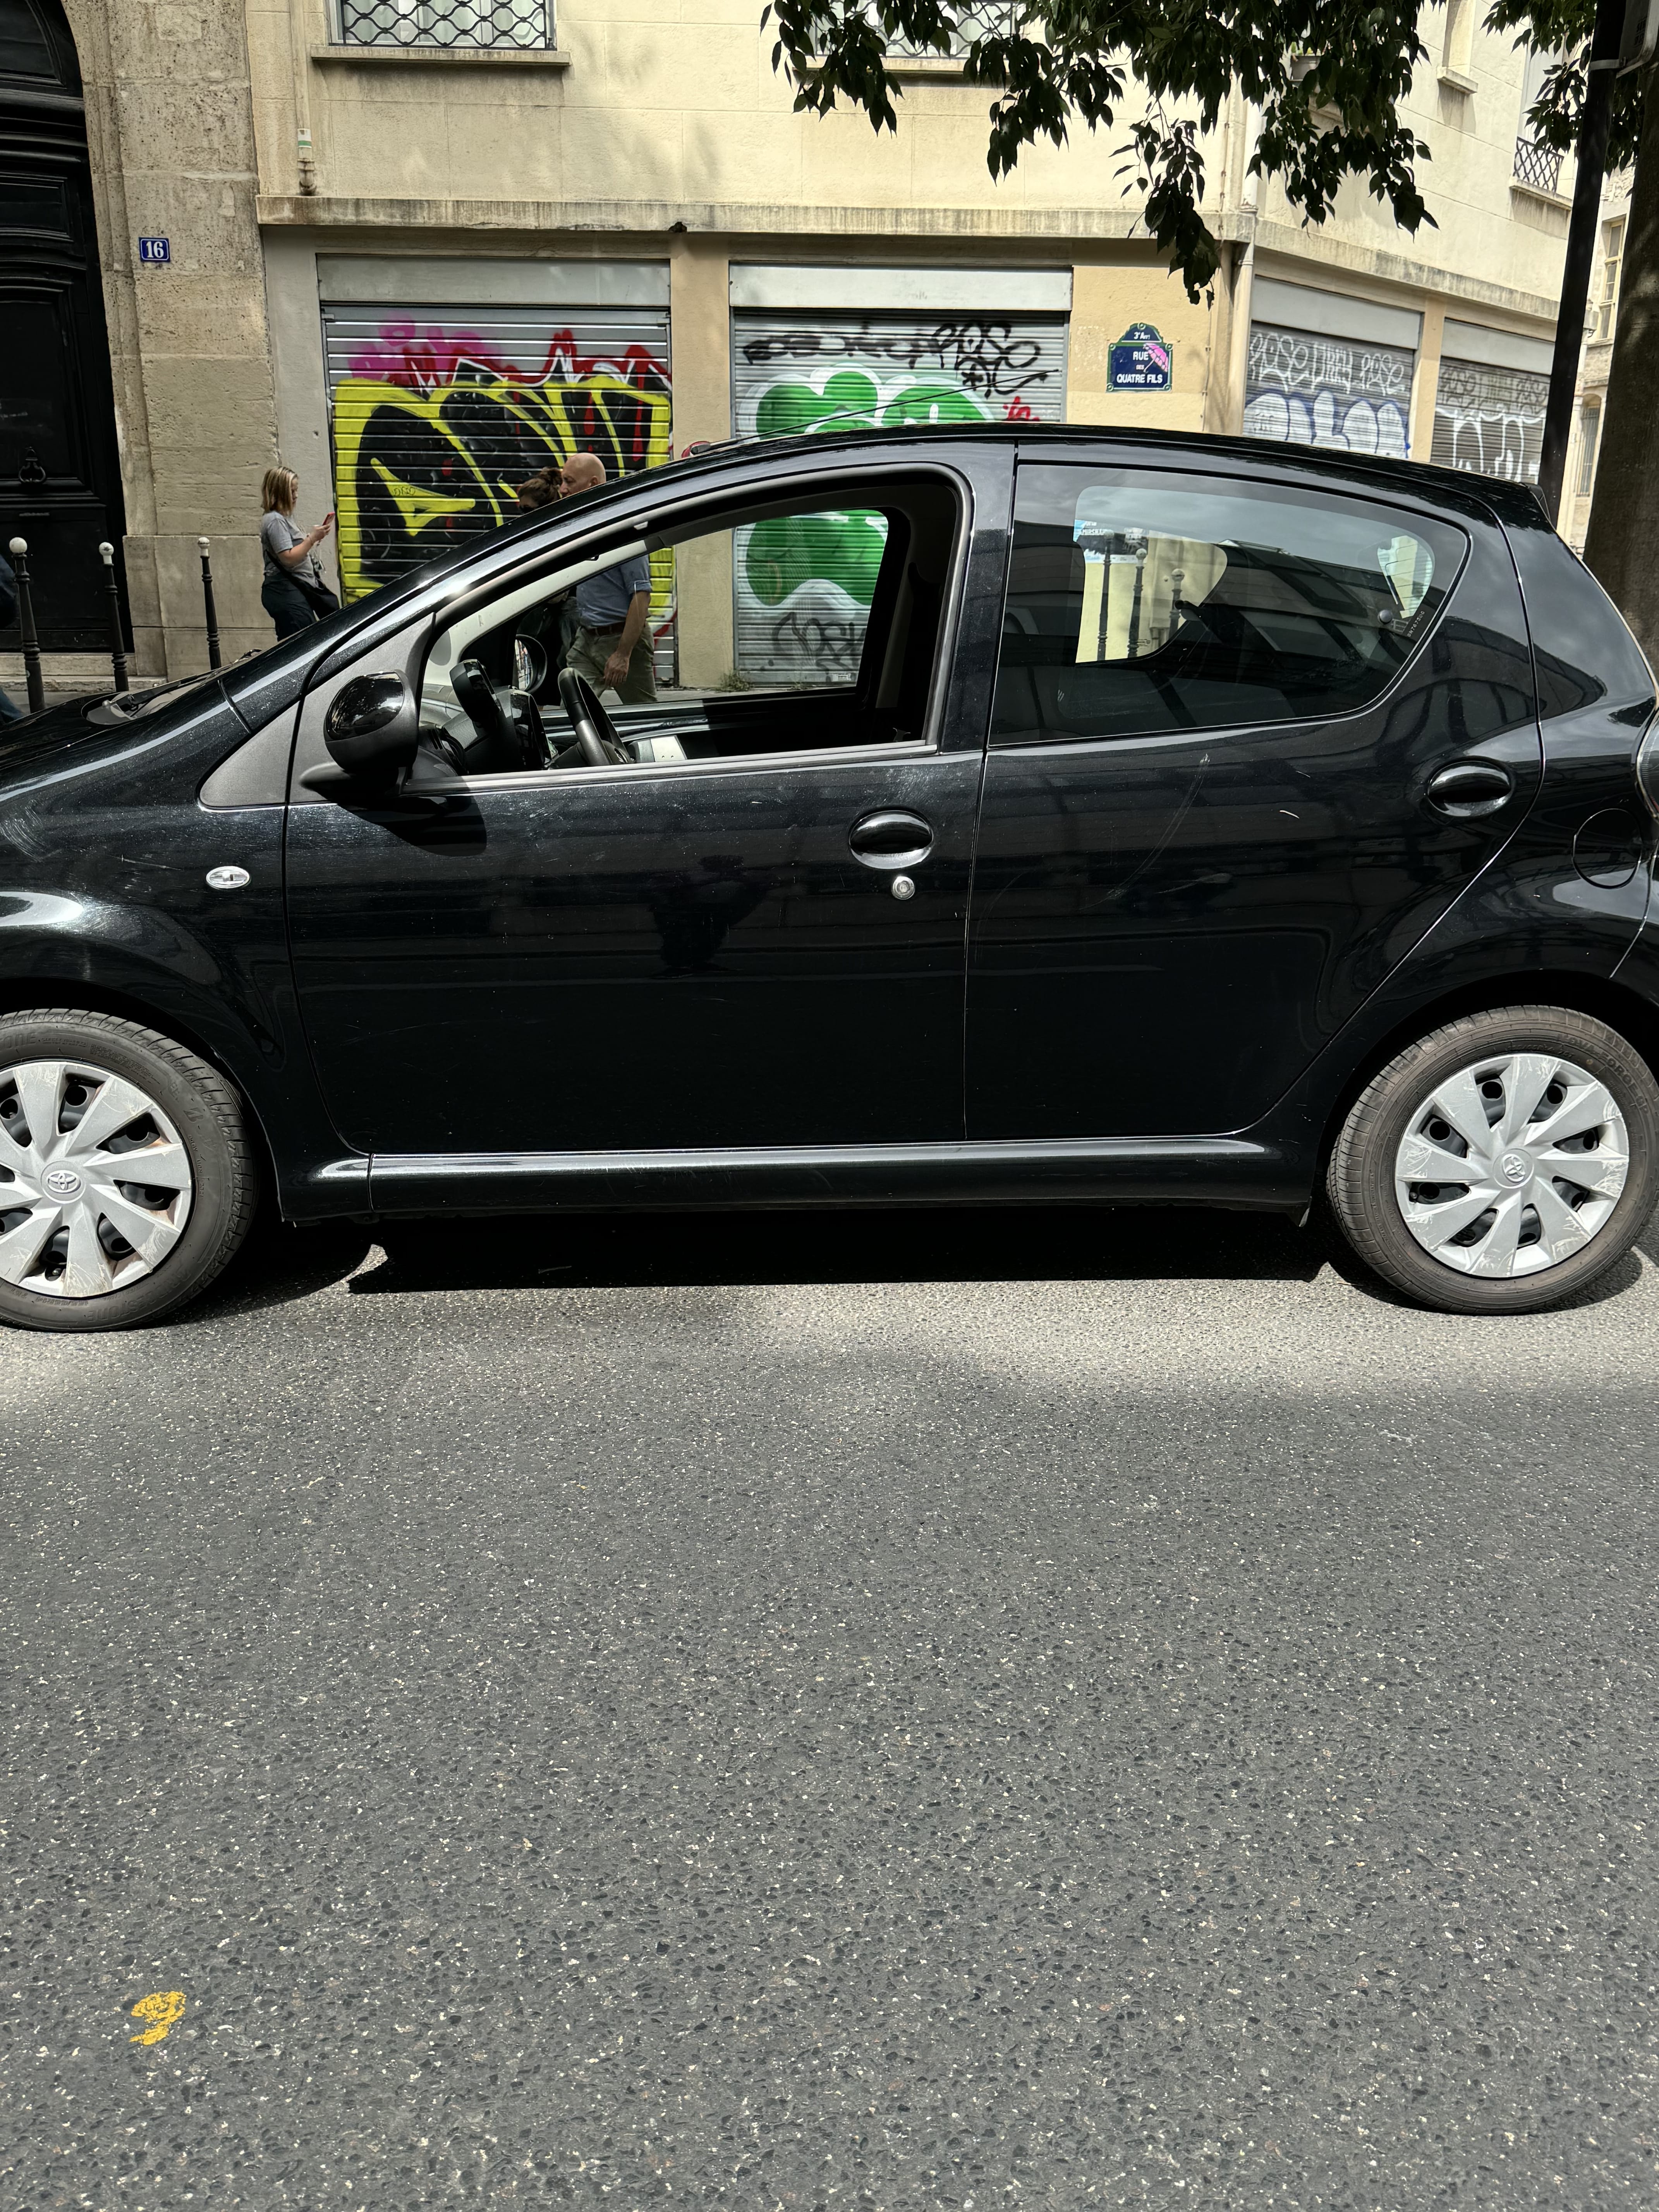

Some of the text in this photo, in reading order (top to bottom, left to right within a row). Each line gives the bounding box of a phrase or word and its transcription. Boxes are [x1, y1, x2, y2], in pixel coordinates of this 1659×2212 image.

[146, 241, 164, 258] 16
[1133, 351, 1149, 361] RUE
[1116, 374, 1163, 383] QUATRE FILS
